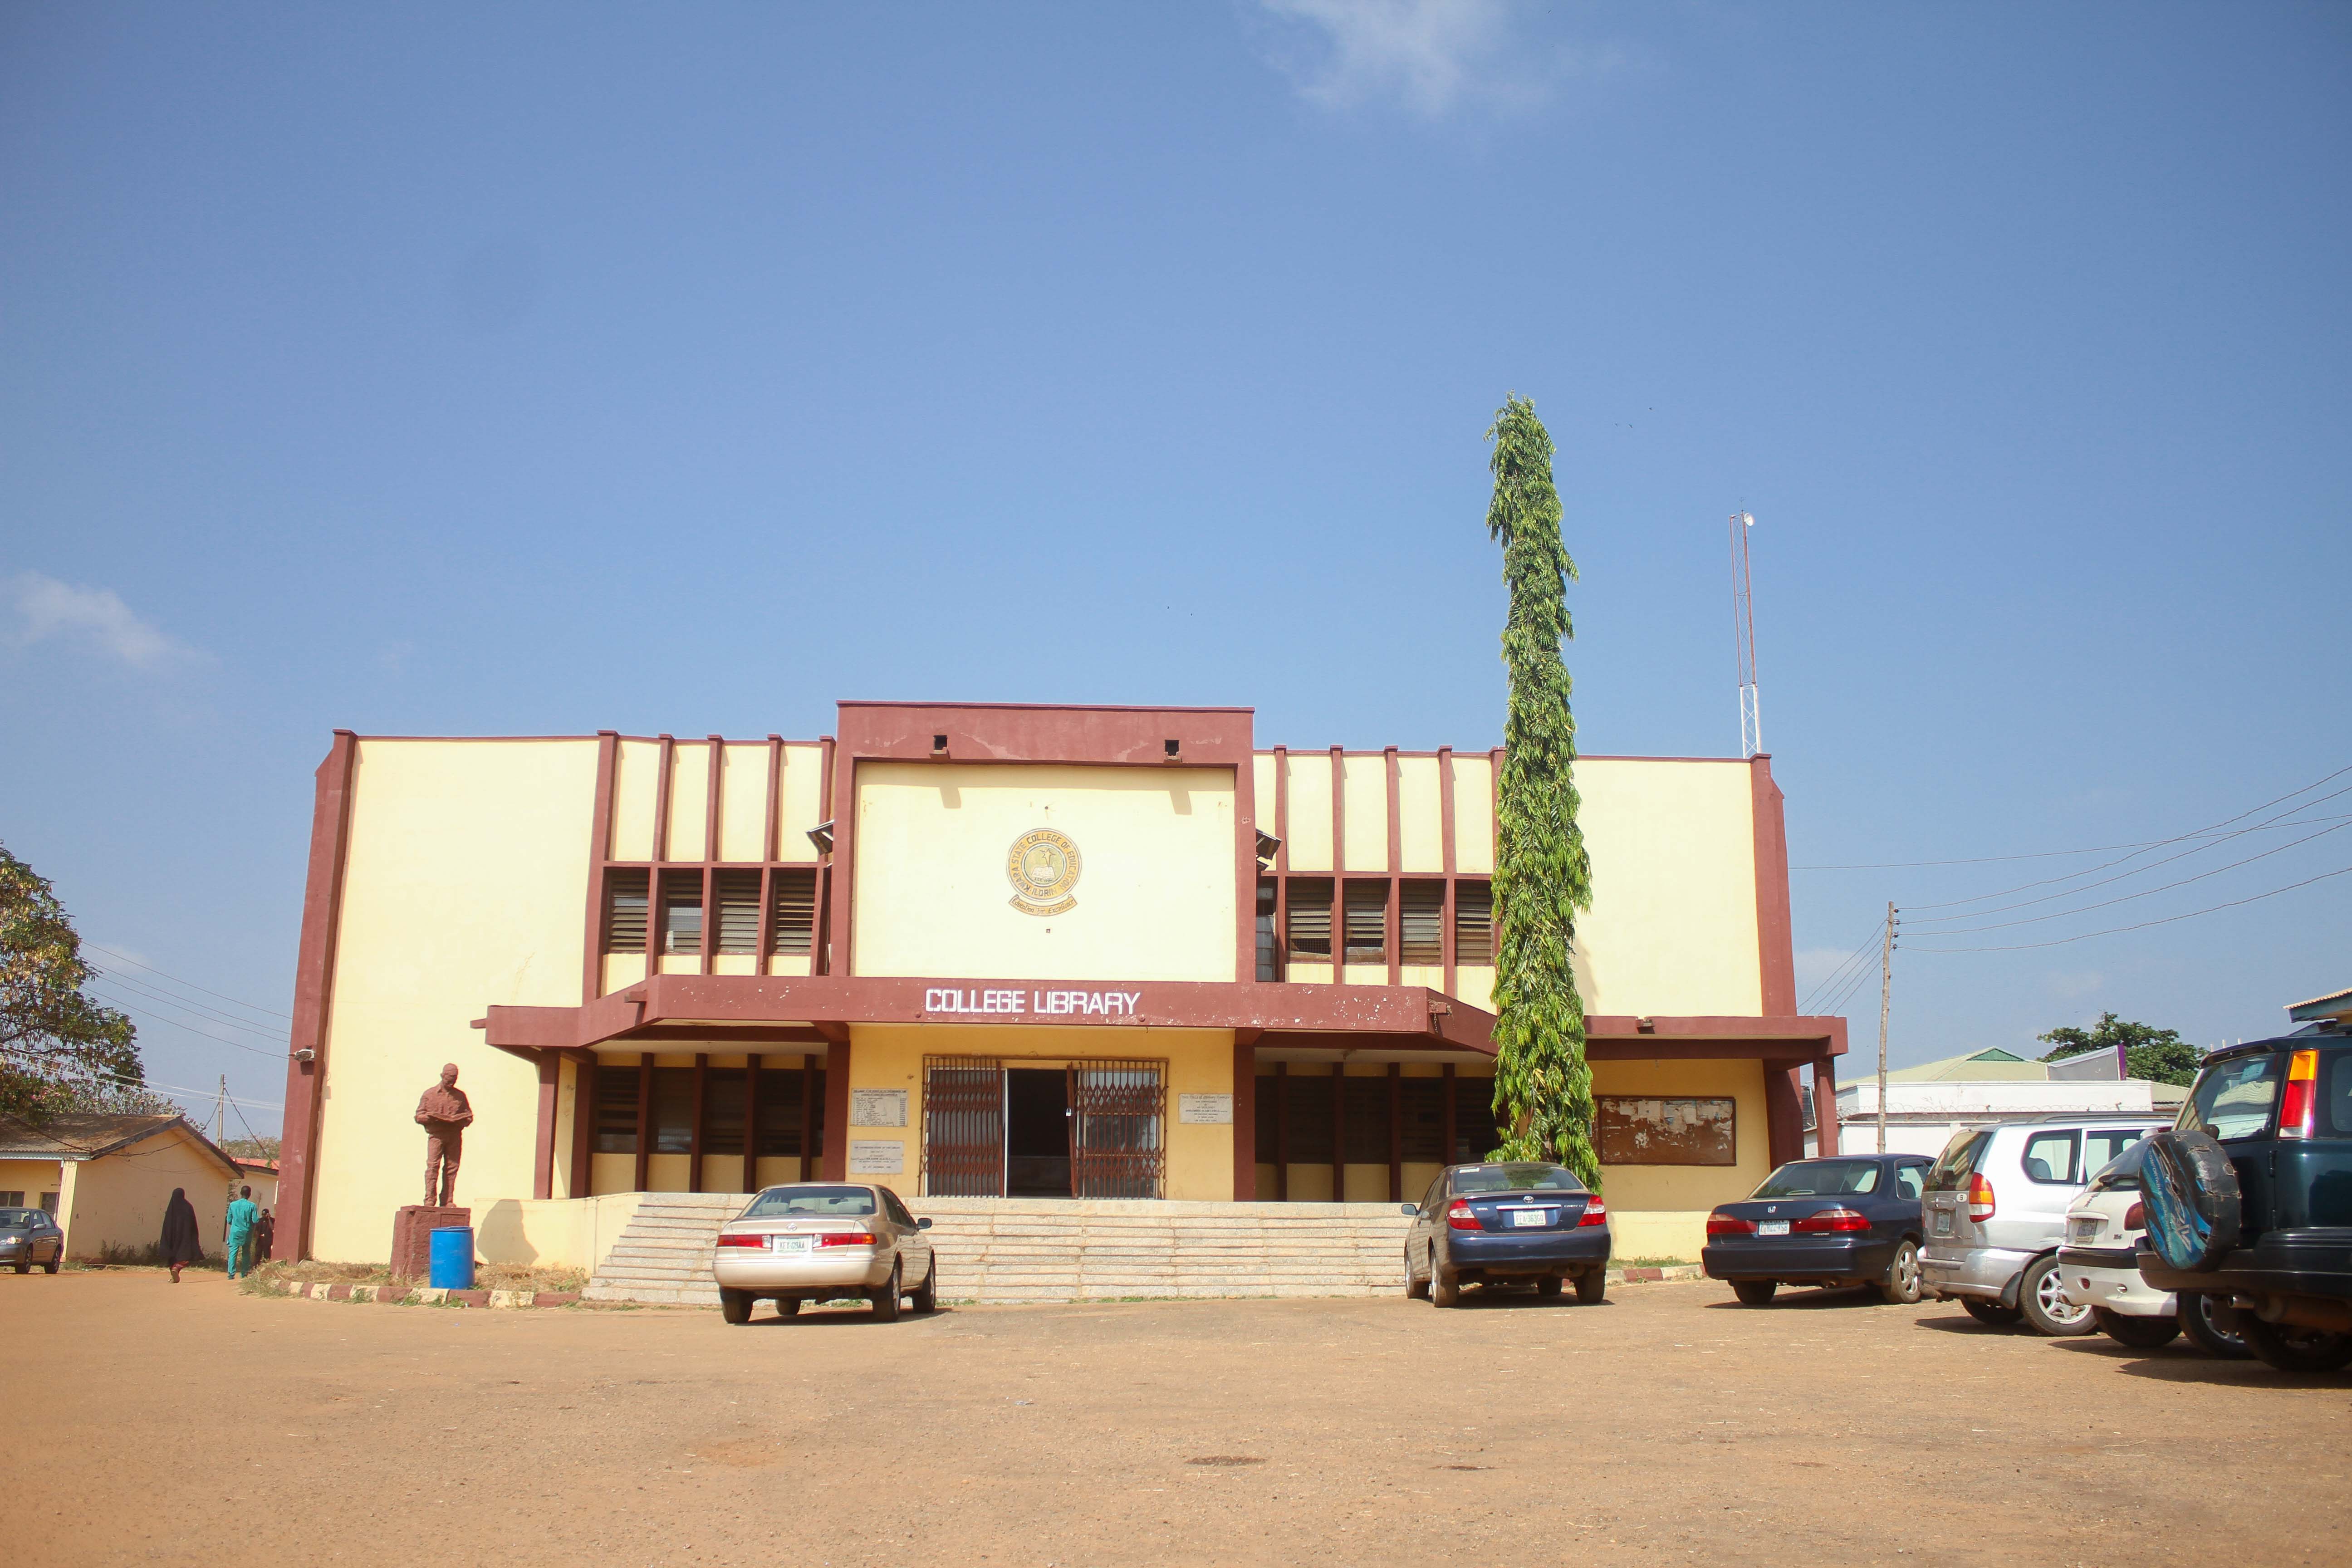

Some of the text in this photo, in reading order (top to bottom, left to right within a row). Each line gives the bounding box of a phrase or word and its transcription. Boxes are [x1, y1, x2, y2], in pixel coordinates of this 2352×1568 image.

[1011, 843, 1027, 864] STATE
[1026, 833, 1062, 844] COLLEGE
[1060, 841, 1070, 852] OF
[1031, 888, 1057, 897] ILORIN
[1012, 898, 1034, 913] Education
[926, 989, 1141, 1015] COLLEGE LIBRARY
